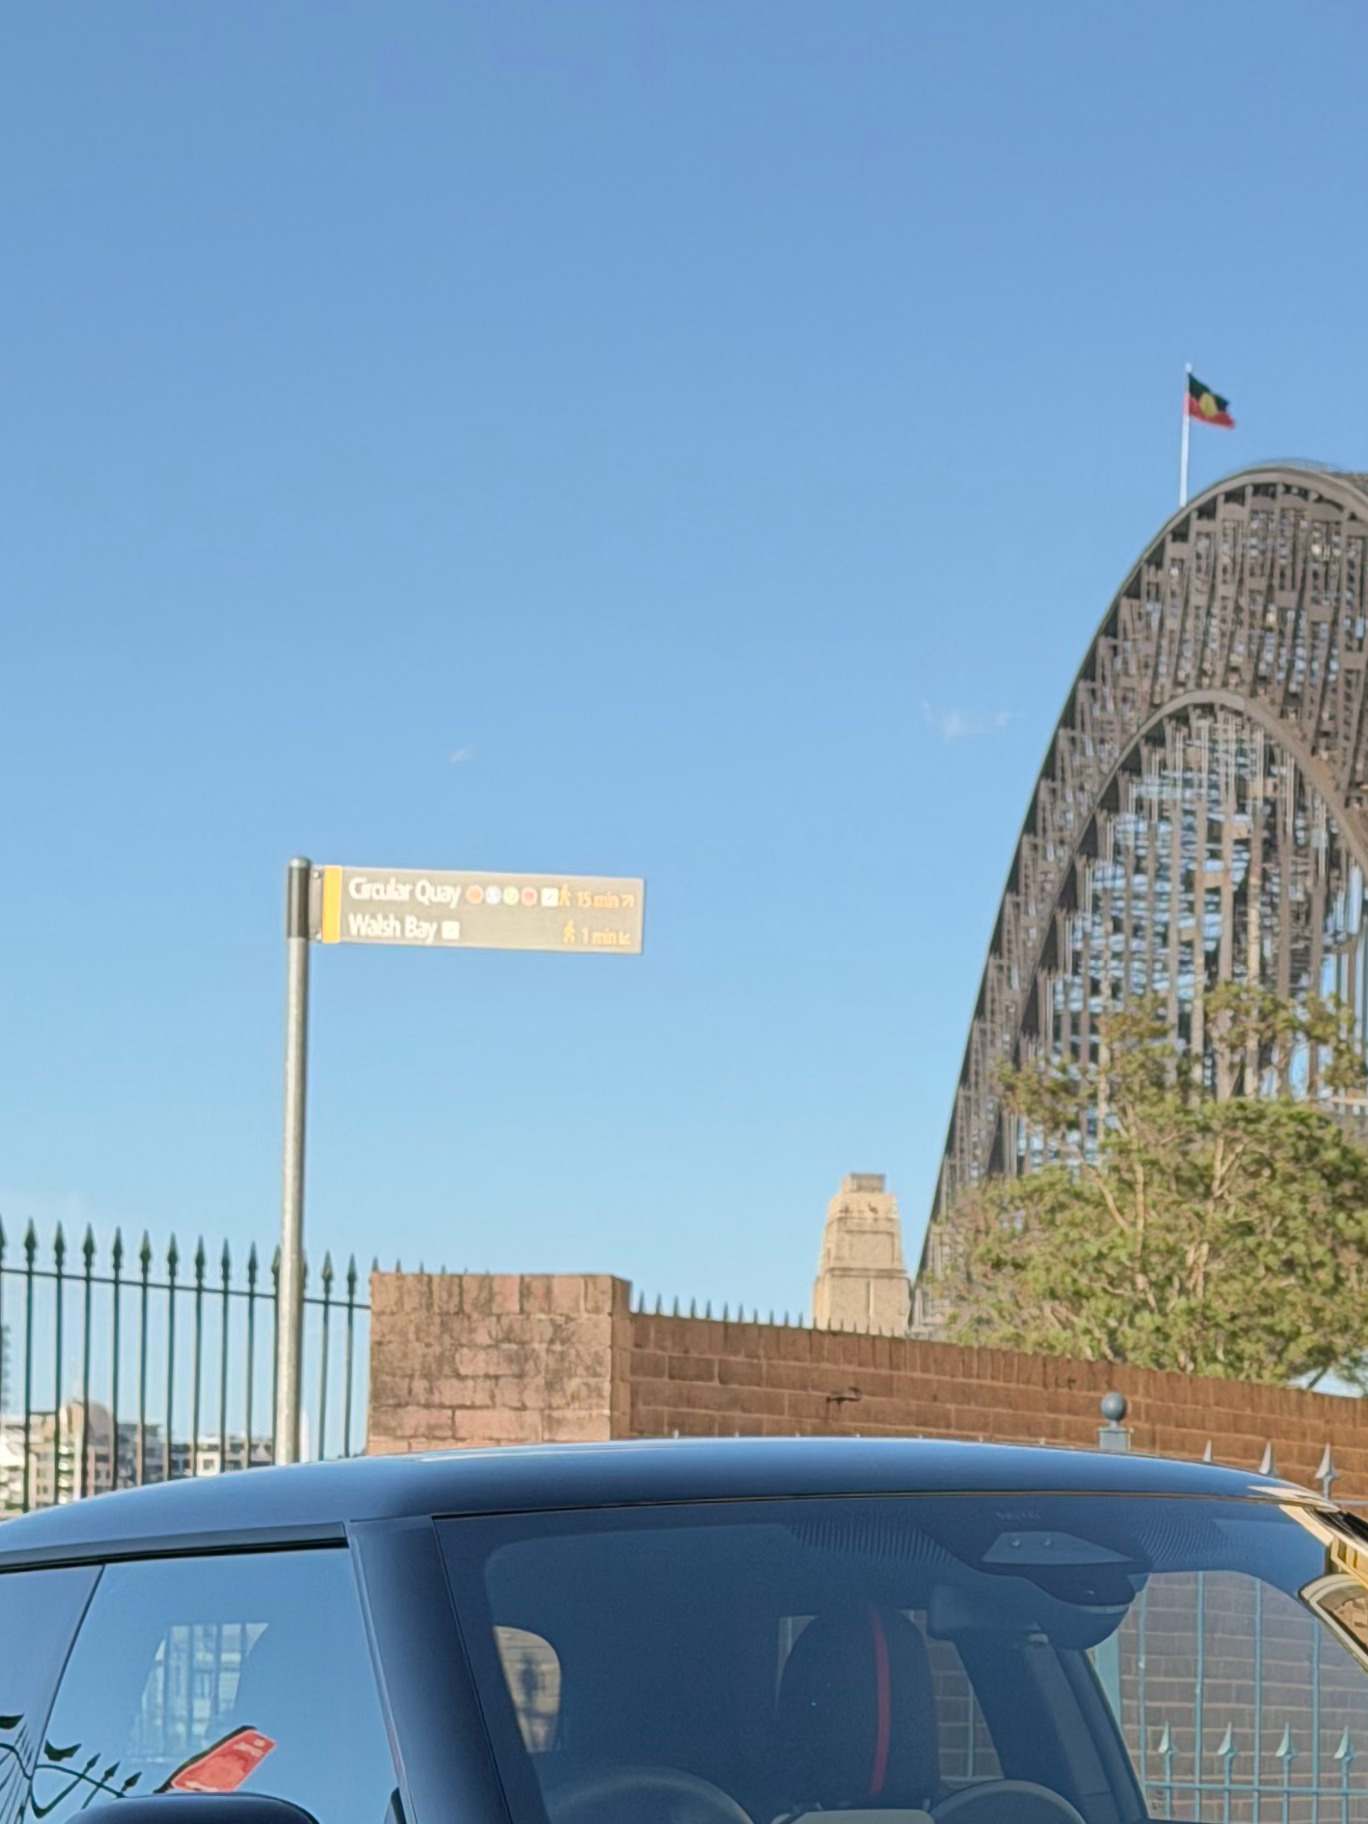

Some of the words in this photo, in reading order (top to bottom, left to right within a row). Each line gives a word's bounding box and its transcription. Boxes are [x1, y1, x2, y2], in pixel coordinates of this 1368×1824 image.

[348, 877, 412, 901] Circular
[415, 878, 462, 909] Quay
[577, 890, 592, 908] 15
[593, 891, 620, 909] min
[348, 912, 401, 937] Walsh
[404, 914, 437, 945] Bay
[582, 927, 589, 945] 1
[592, 928, 618, 945] min
